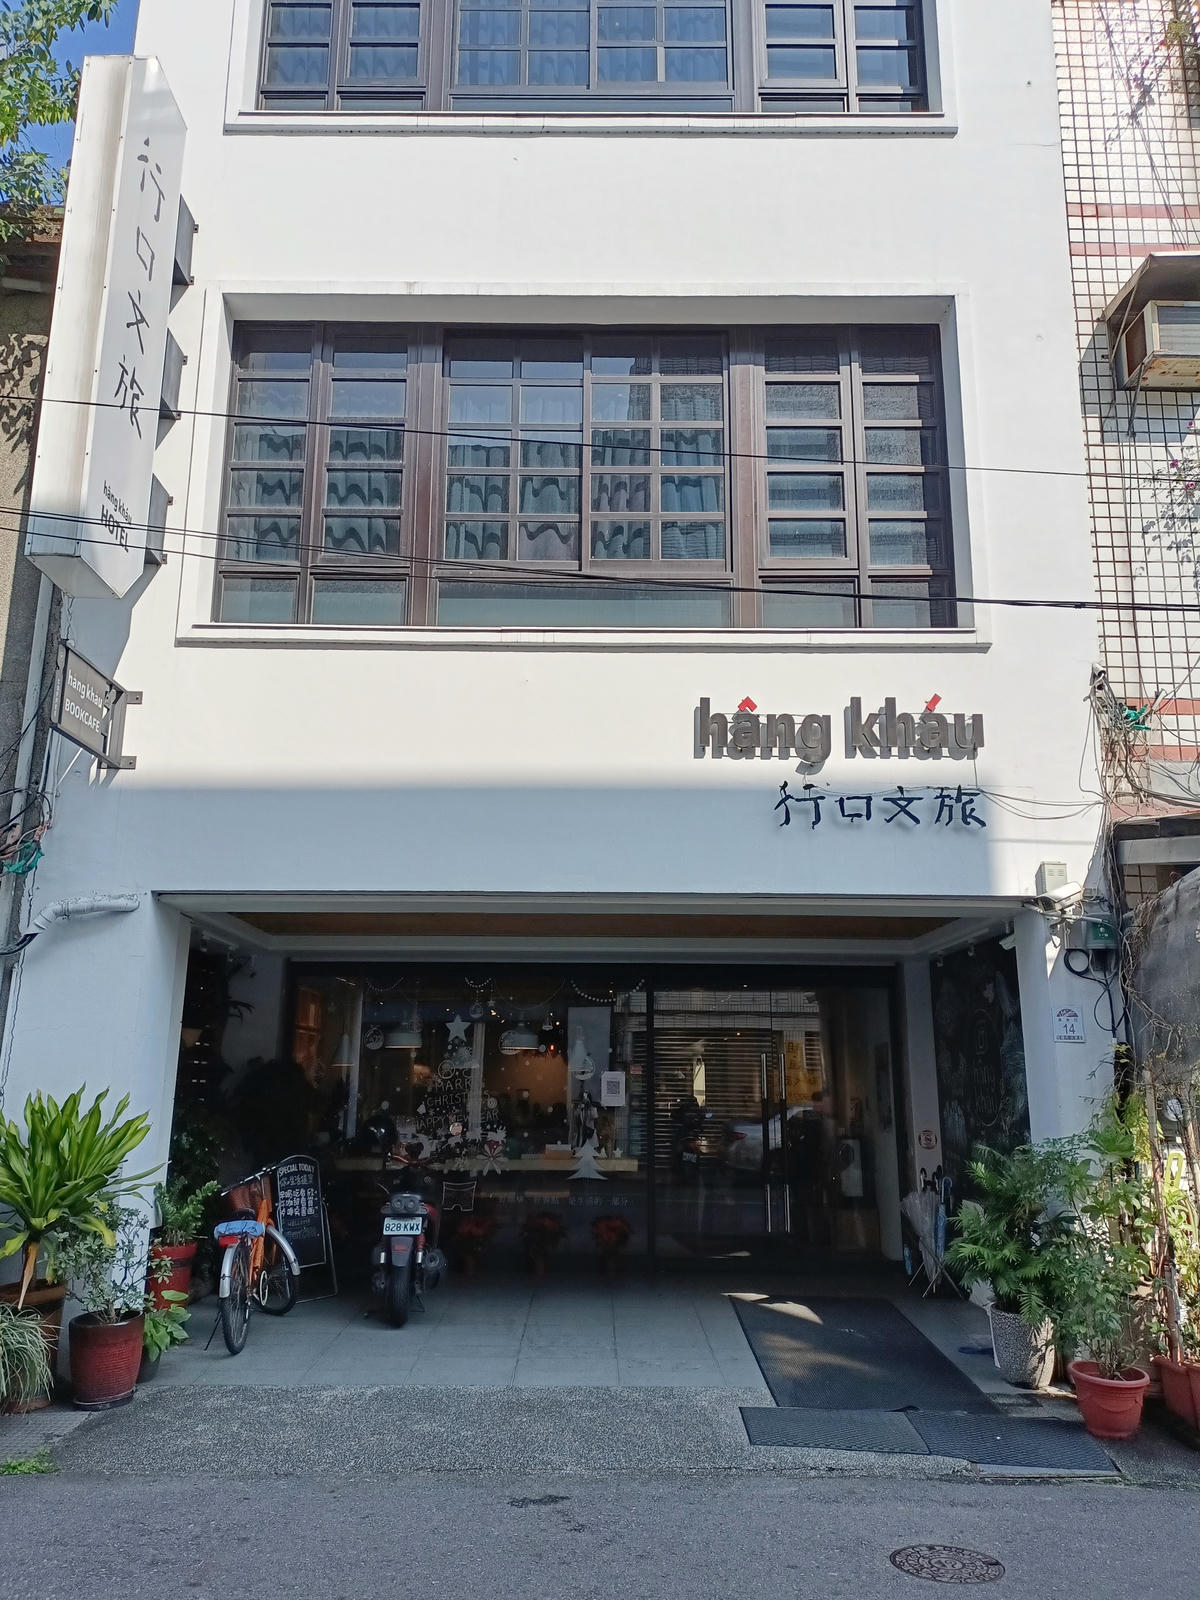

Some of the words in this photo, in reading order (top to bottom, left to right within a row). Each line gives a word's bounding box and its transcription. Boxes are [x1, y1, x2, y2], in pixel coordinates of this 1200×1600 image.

[101, 504, 129, 553] HOTEL
[65, 698, 101, 733] BOOKCAFE
[774, 780, 986, 829] 行口文旅
[1063, 1023, 1076, 1034] 14
